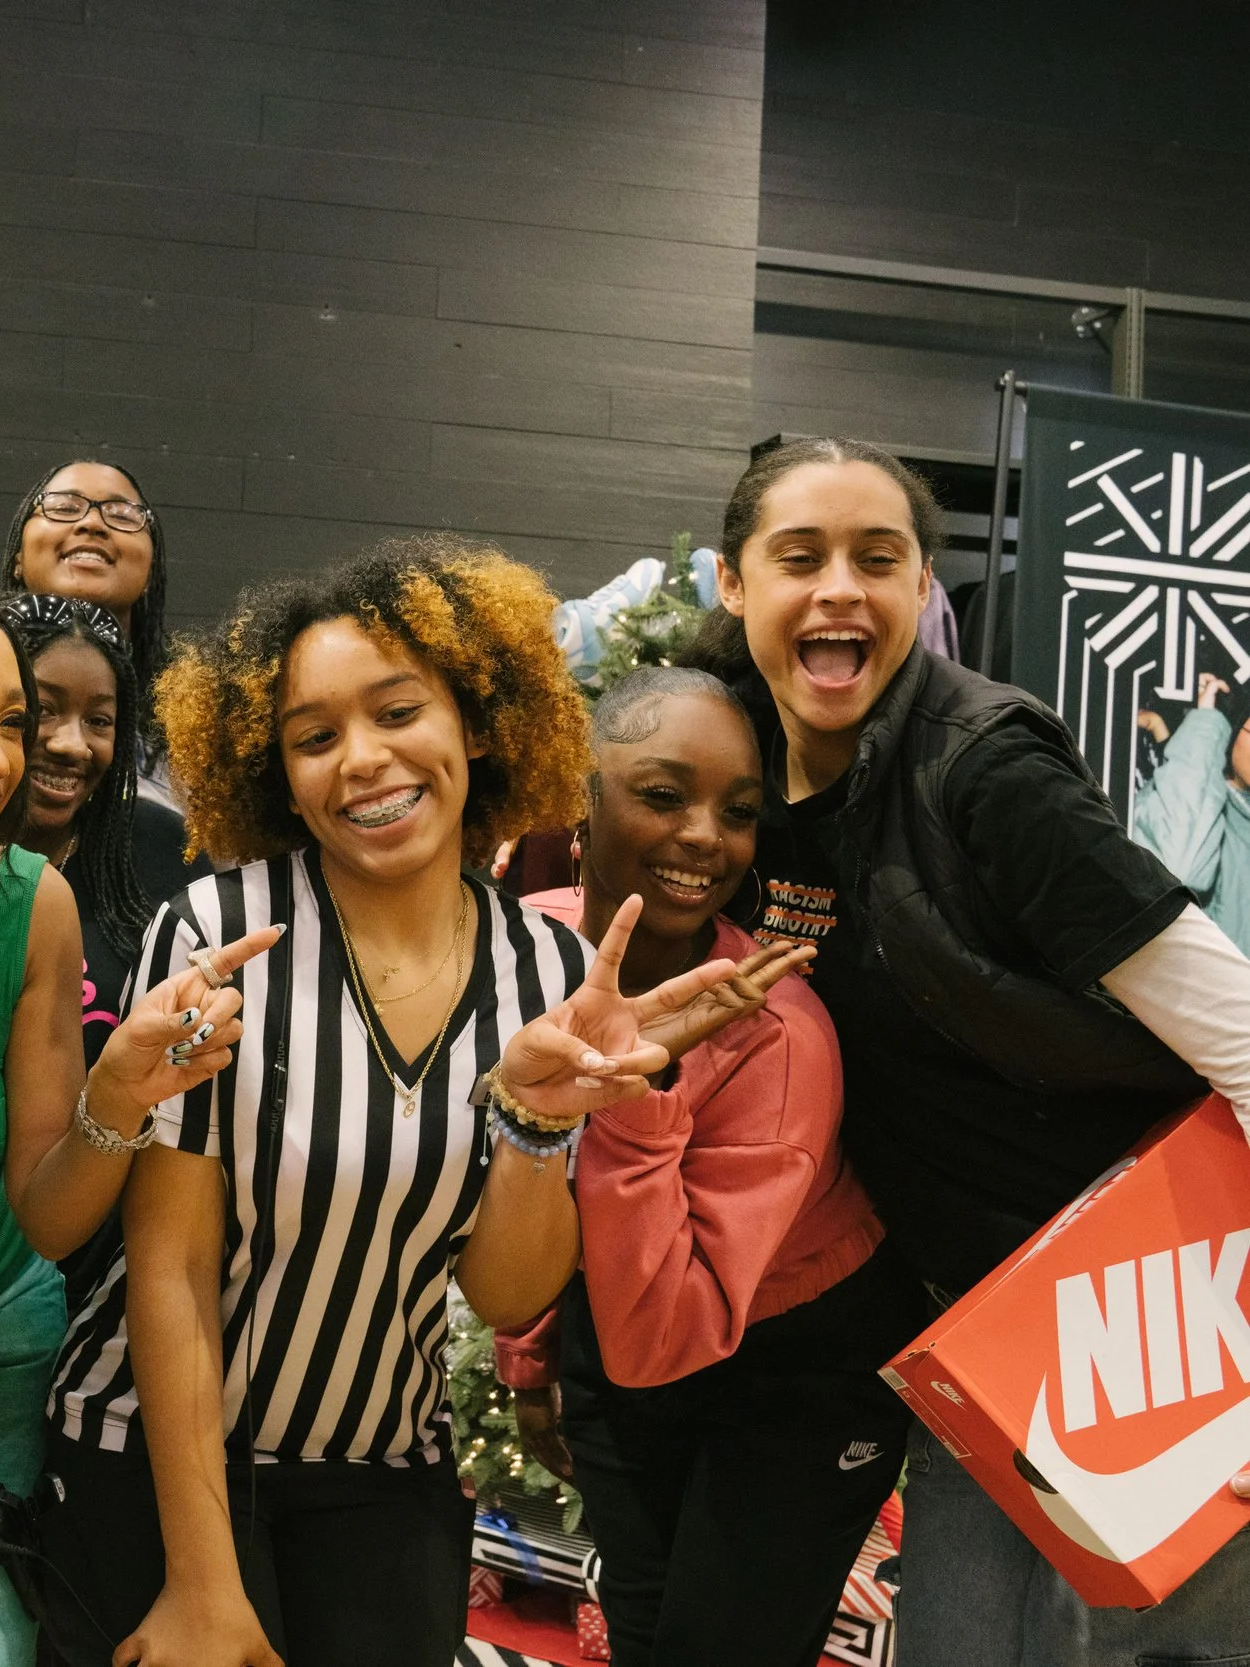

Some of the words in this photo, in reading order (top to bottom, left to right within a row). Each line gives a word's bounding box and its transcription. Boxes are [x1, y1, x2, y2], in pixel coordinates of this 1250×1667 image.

[768, 879, 834, 910] RACISM
[763, 905, 837, 936] BIGOTRY
[939, 1383, 966, 1404] NIKE
[846, 1441, 878, 1459] NIKE
